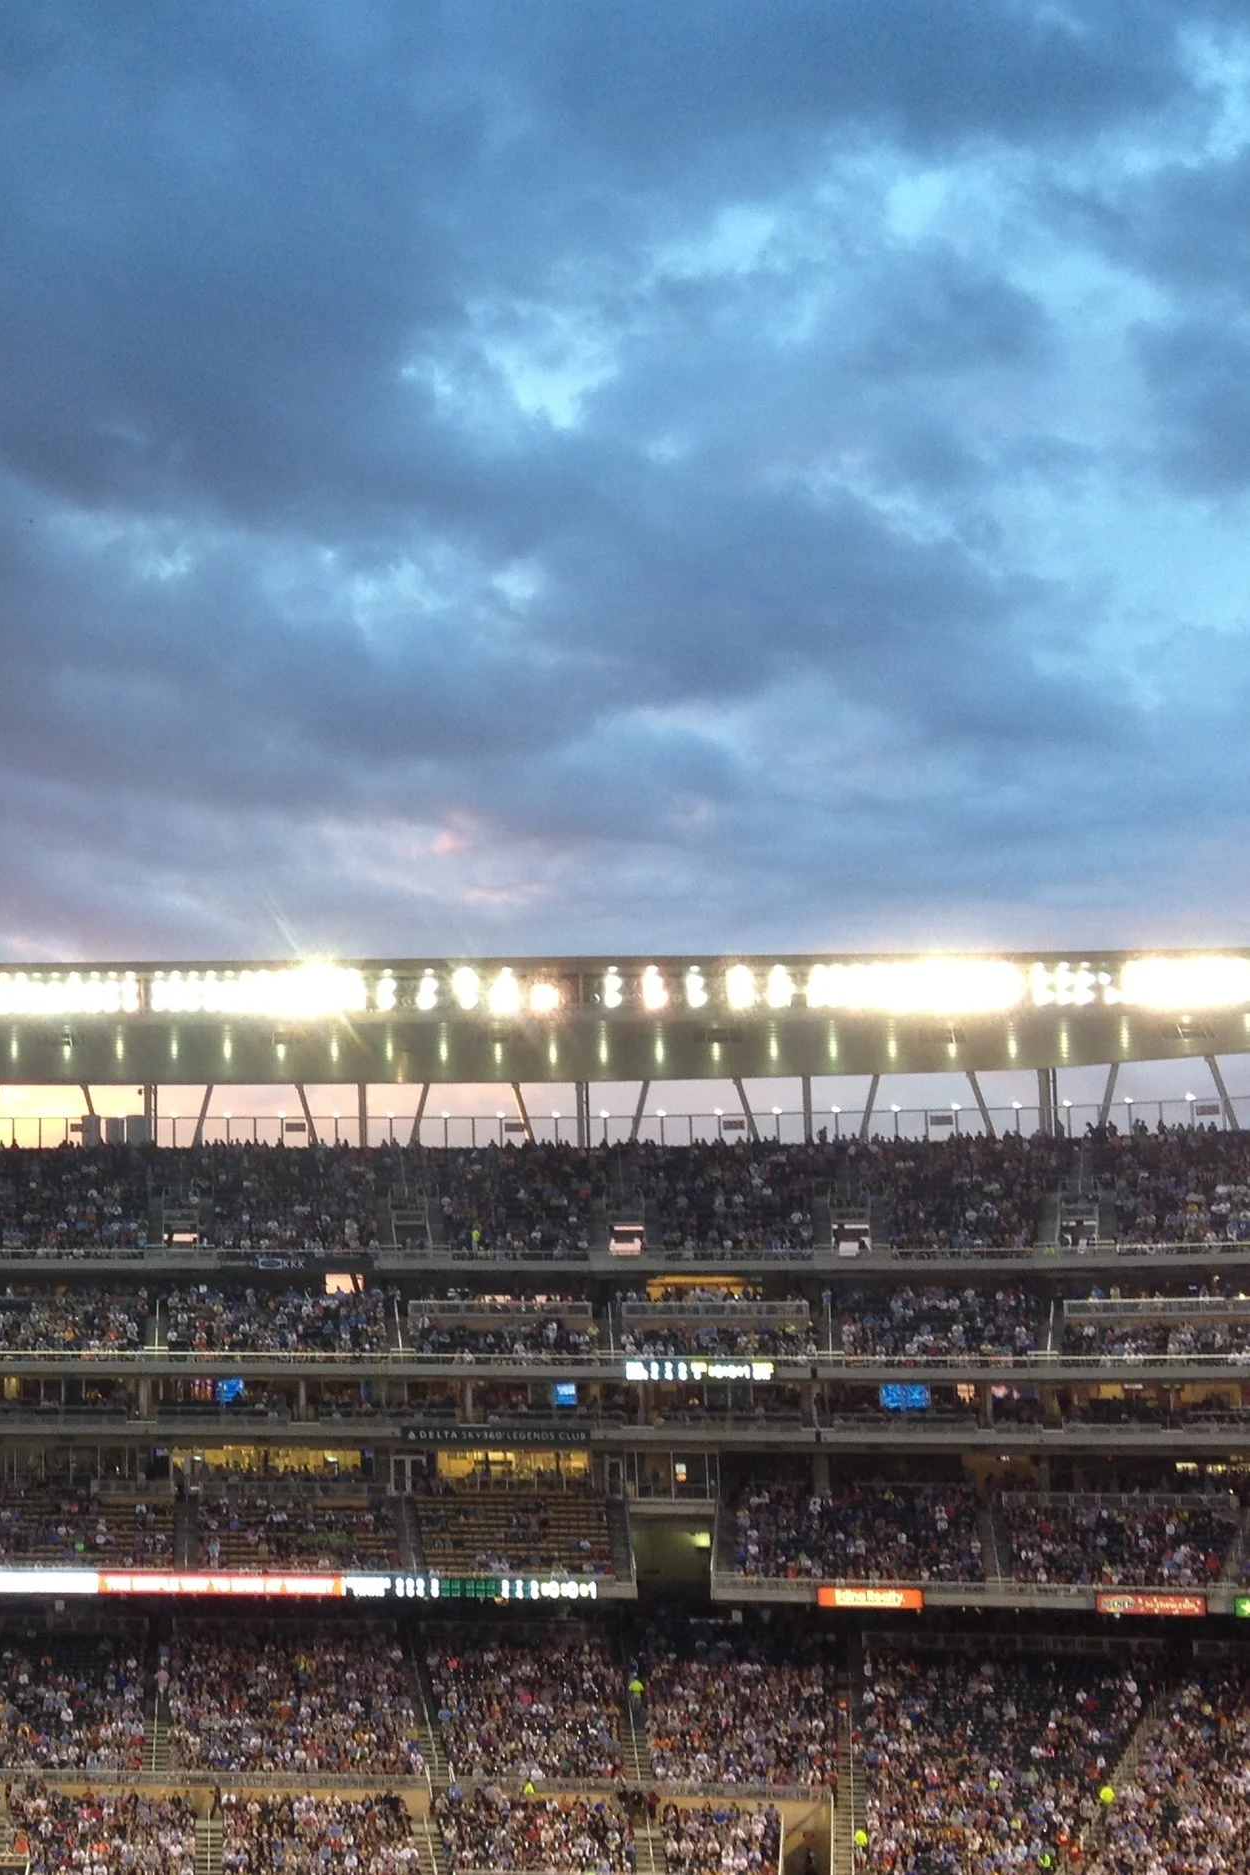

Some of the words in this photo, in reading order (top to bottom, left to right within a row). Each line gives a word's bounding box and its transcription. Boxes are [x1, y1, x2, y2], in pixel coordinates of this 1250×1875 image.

[419, 1429, 458, 1440] DELTA
[507, 1430, 556, 1441] LEGENDS
[557, 1431, 587, 1442] CLUB
